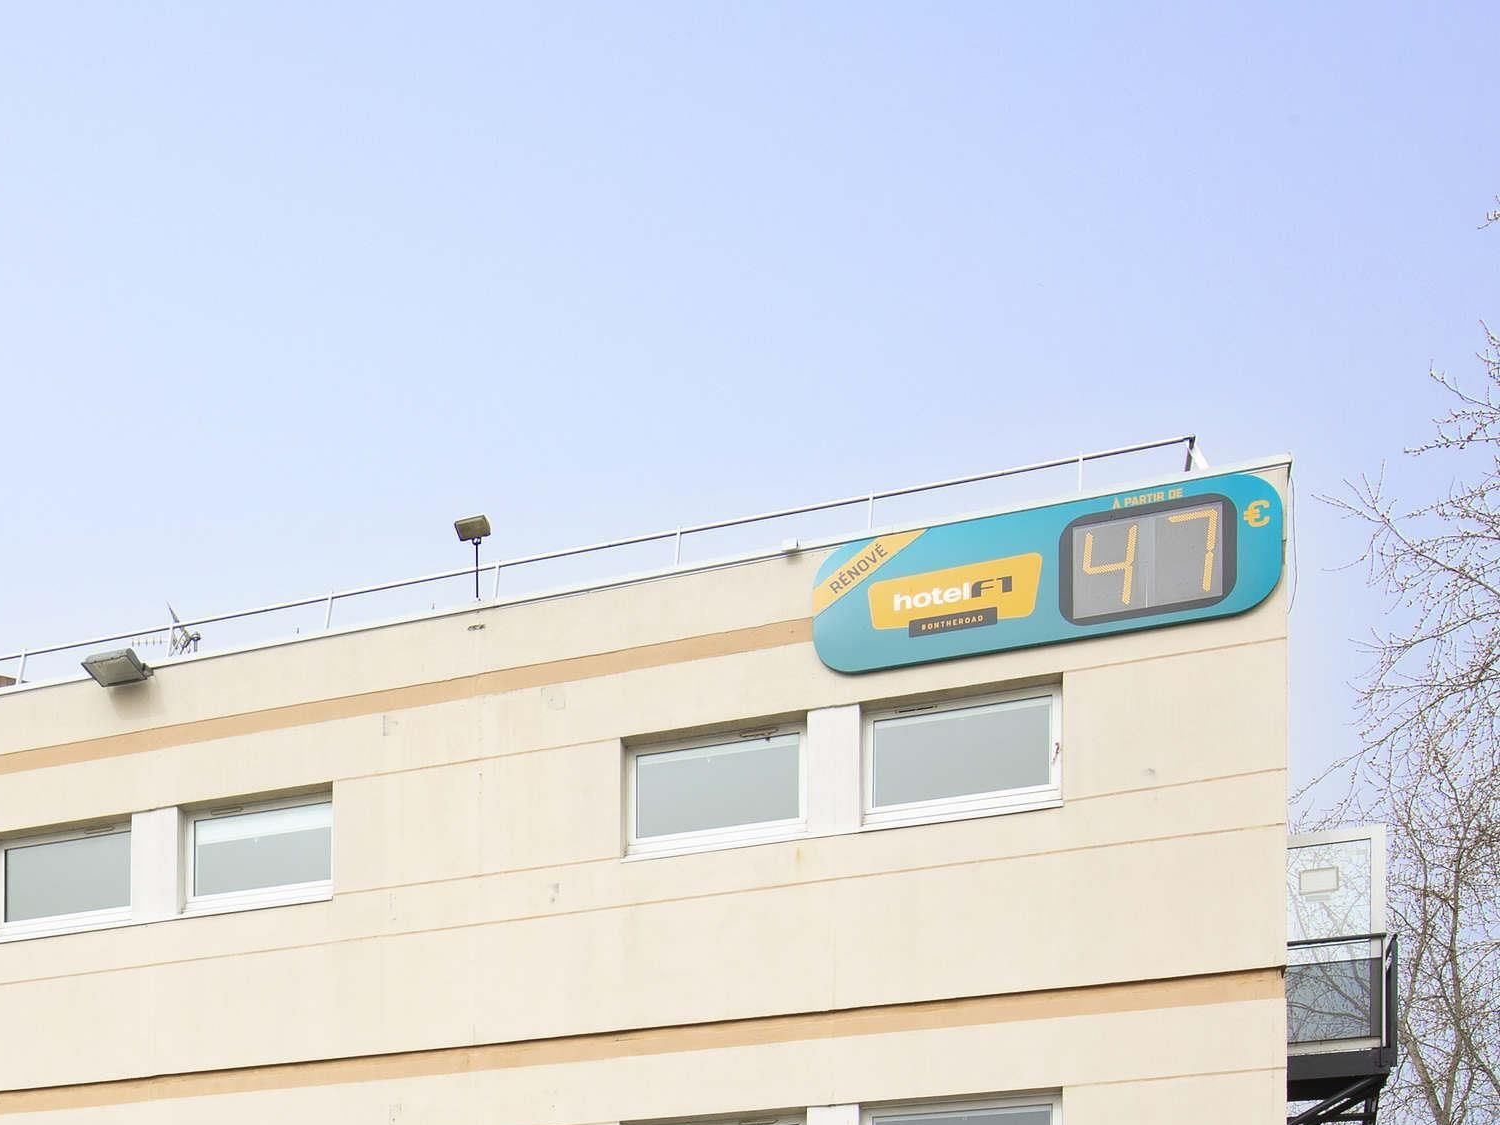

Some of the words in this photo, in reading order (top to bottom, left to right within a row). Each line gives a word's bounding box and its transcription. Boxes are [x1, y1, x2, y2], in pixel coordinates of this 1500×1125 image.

[1123, 491, 1165, 508] PARTIR
[1168, 488, 1184, 500] DE
[1243, 499, 1271, 528] €
[829, 543, 889, 595] RÉNOVÉ
[1082, 508, 1219, 606] 47
